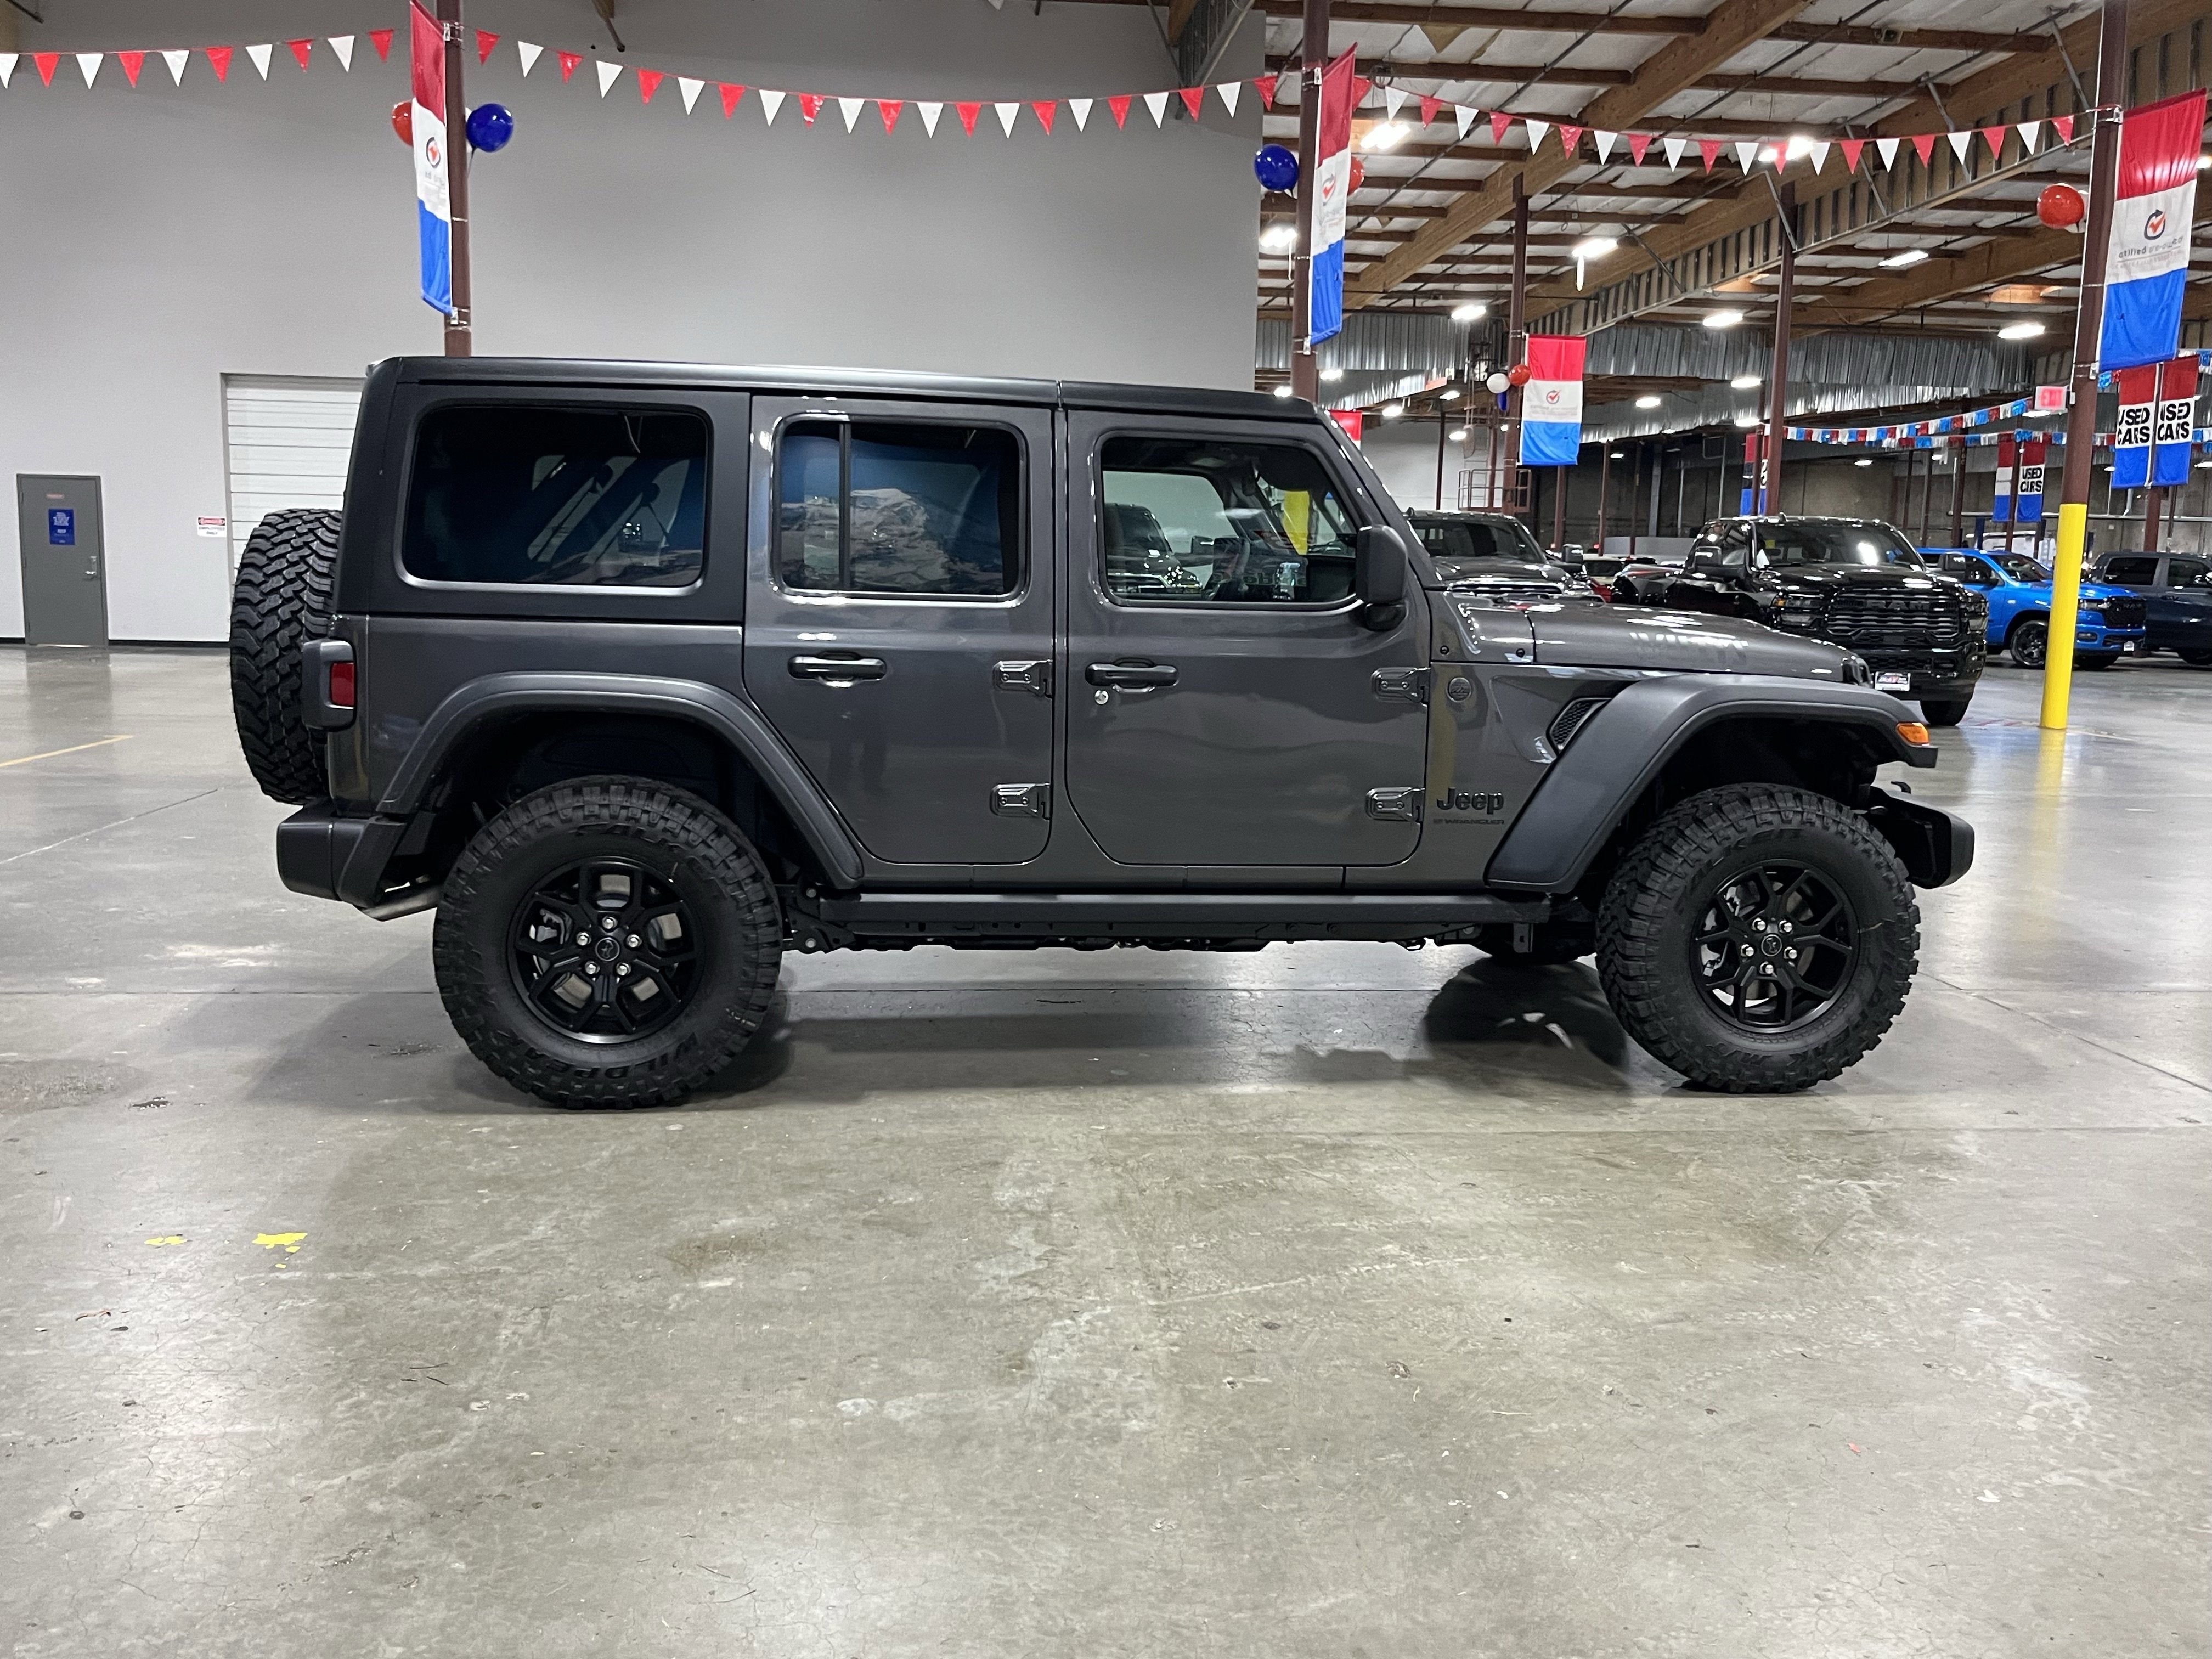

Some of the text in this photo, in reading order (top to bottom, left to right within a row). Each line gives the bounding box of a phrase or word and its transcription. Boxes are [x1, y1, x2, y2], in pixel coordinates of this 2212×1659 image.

[2117, 426, 2150, 444] CARS
[2157, 421, 2190, 441] CARS
[2022, 467, 2042, 479] USED
[1867, 600, 1929, 610] RAM
[1437, 787, 1504, 815] Jeep
